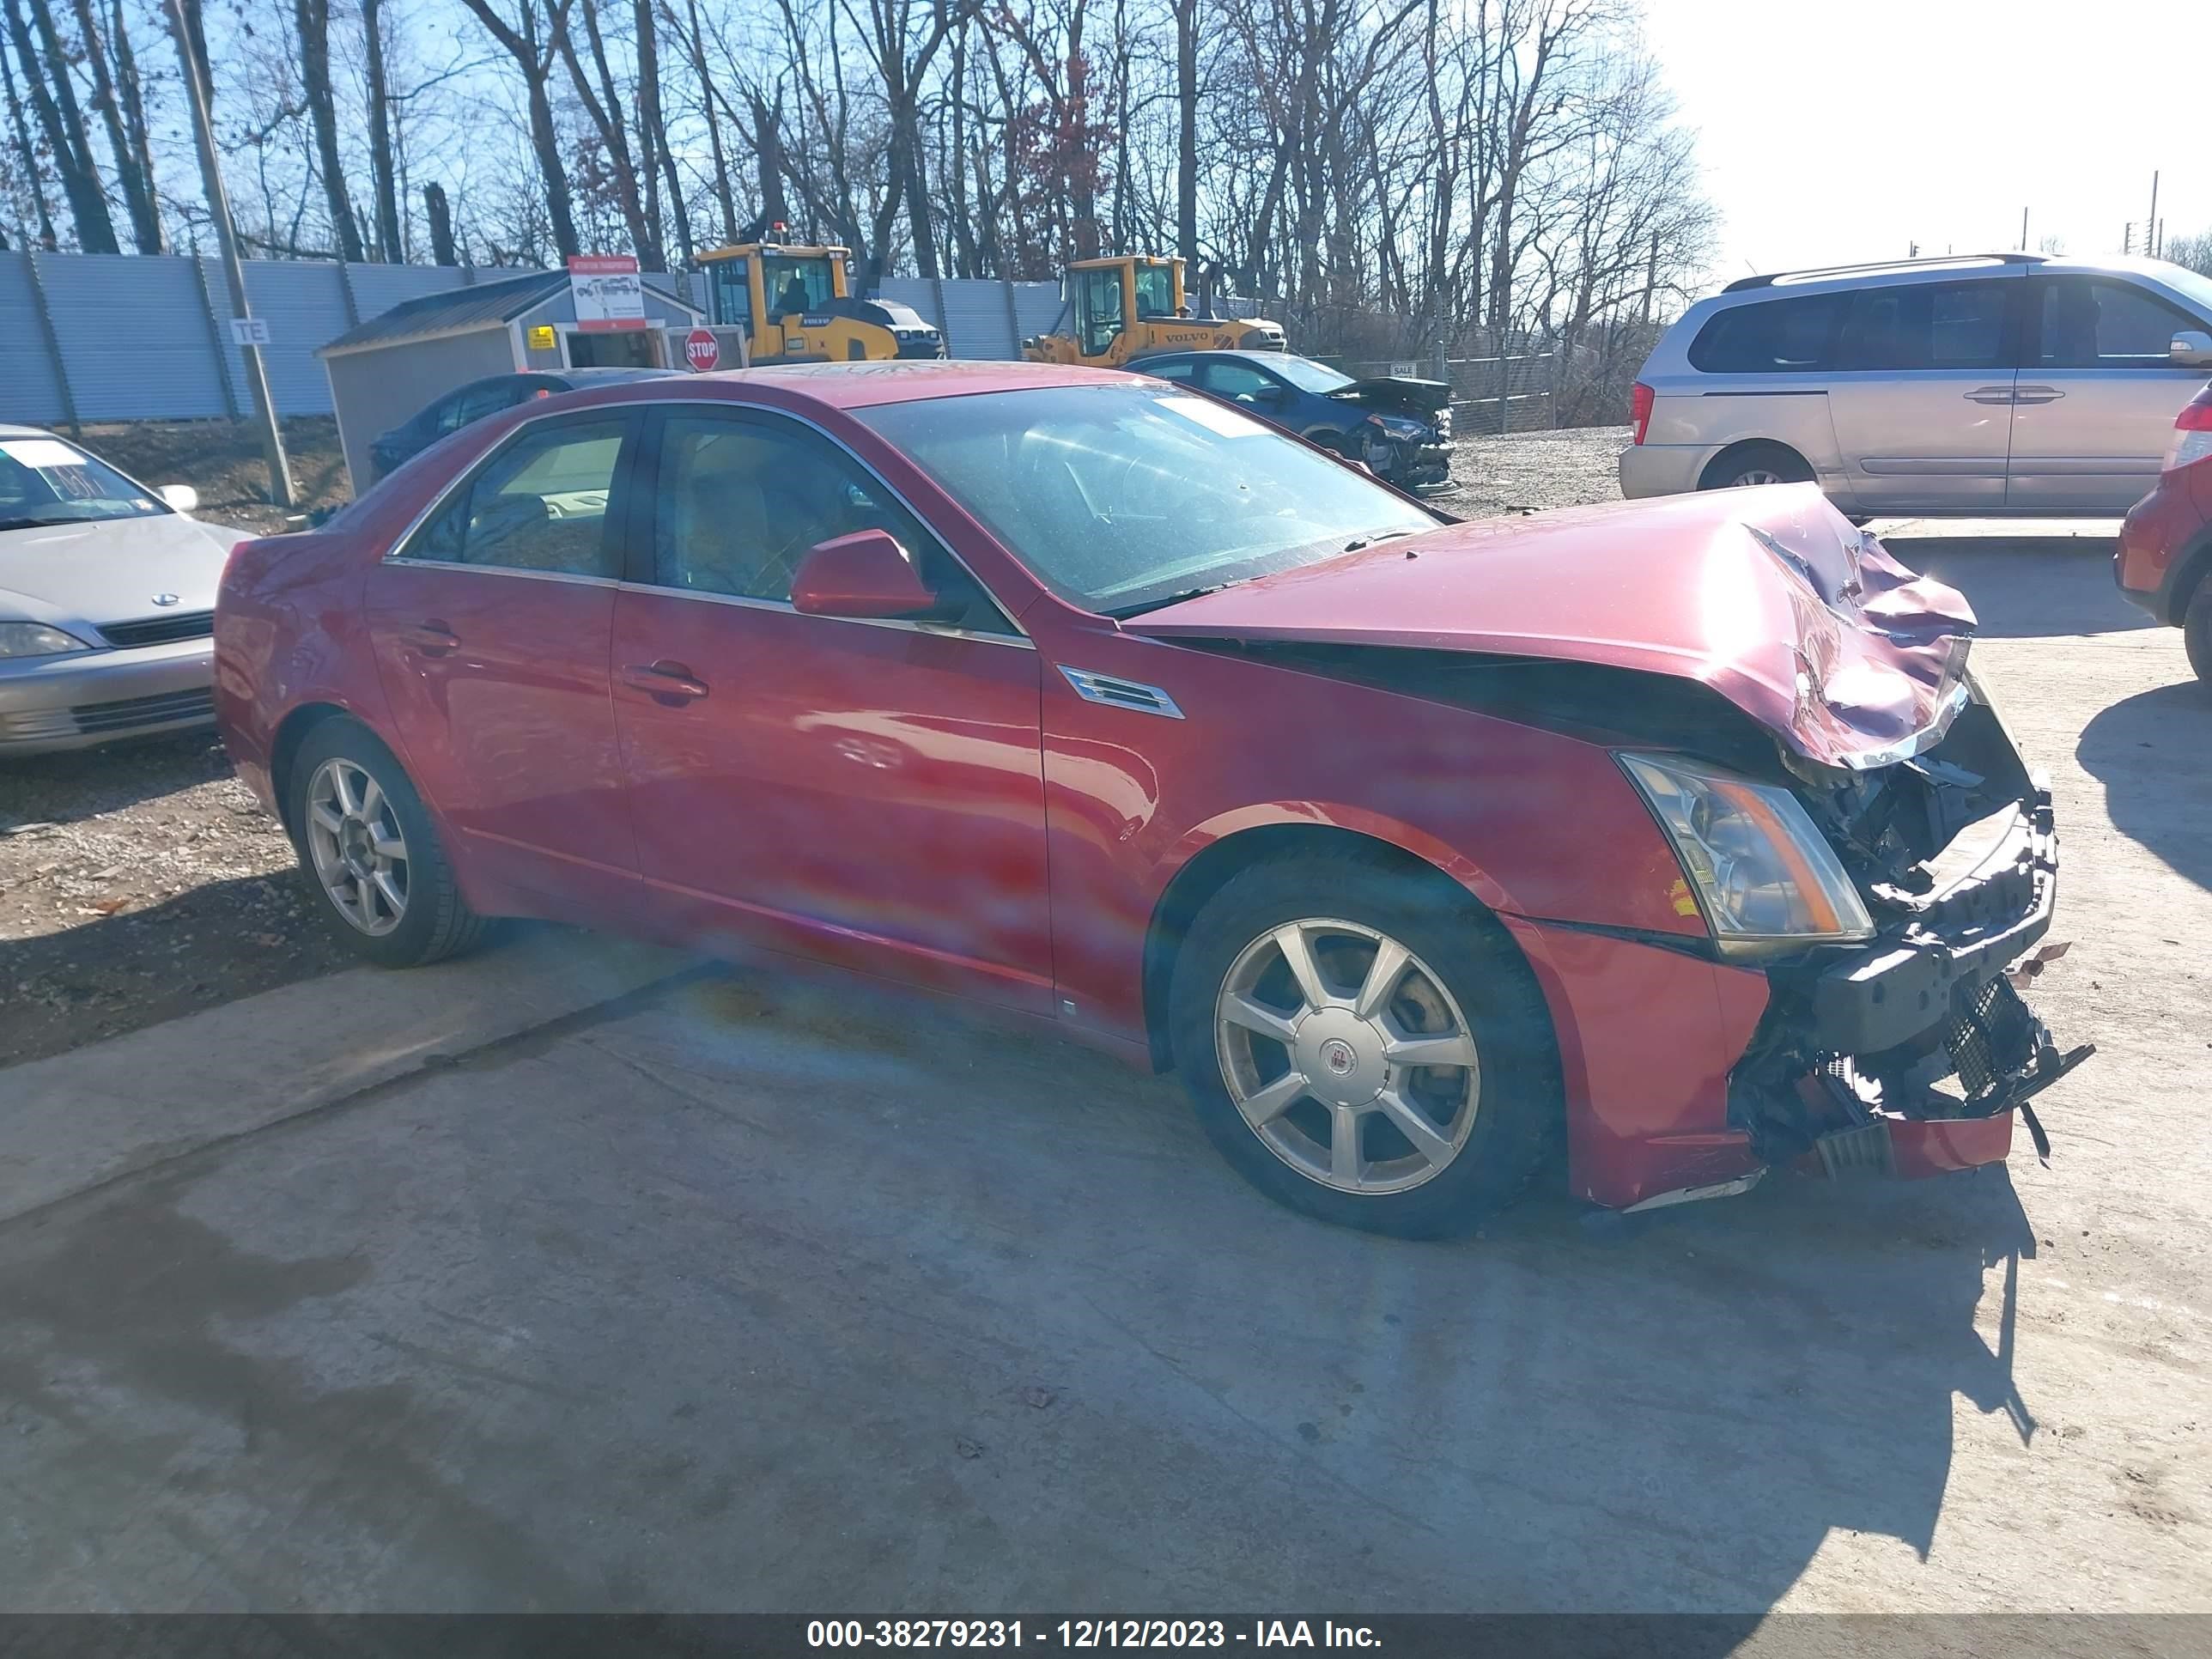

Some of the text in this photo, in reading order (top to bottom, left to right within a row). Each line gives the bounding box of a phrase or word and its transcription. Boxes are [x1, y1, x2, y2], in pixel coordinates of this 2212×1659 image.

[234, 322, 265, 341] TE
[1166, 331, 1209, 343] VOLVO
[688, 342, 716, 358] STOP
[1394, 366, 1413, 375] SALE
